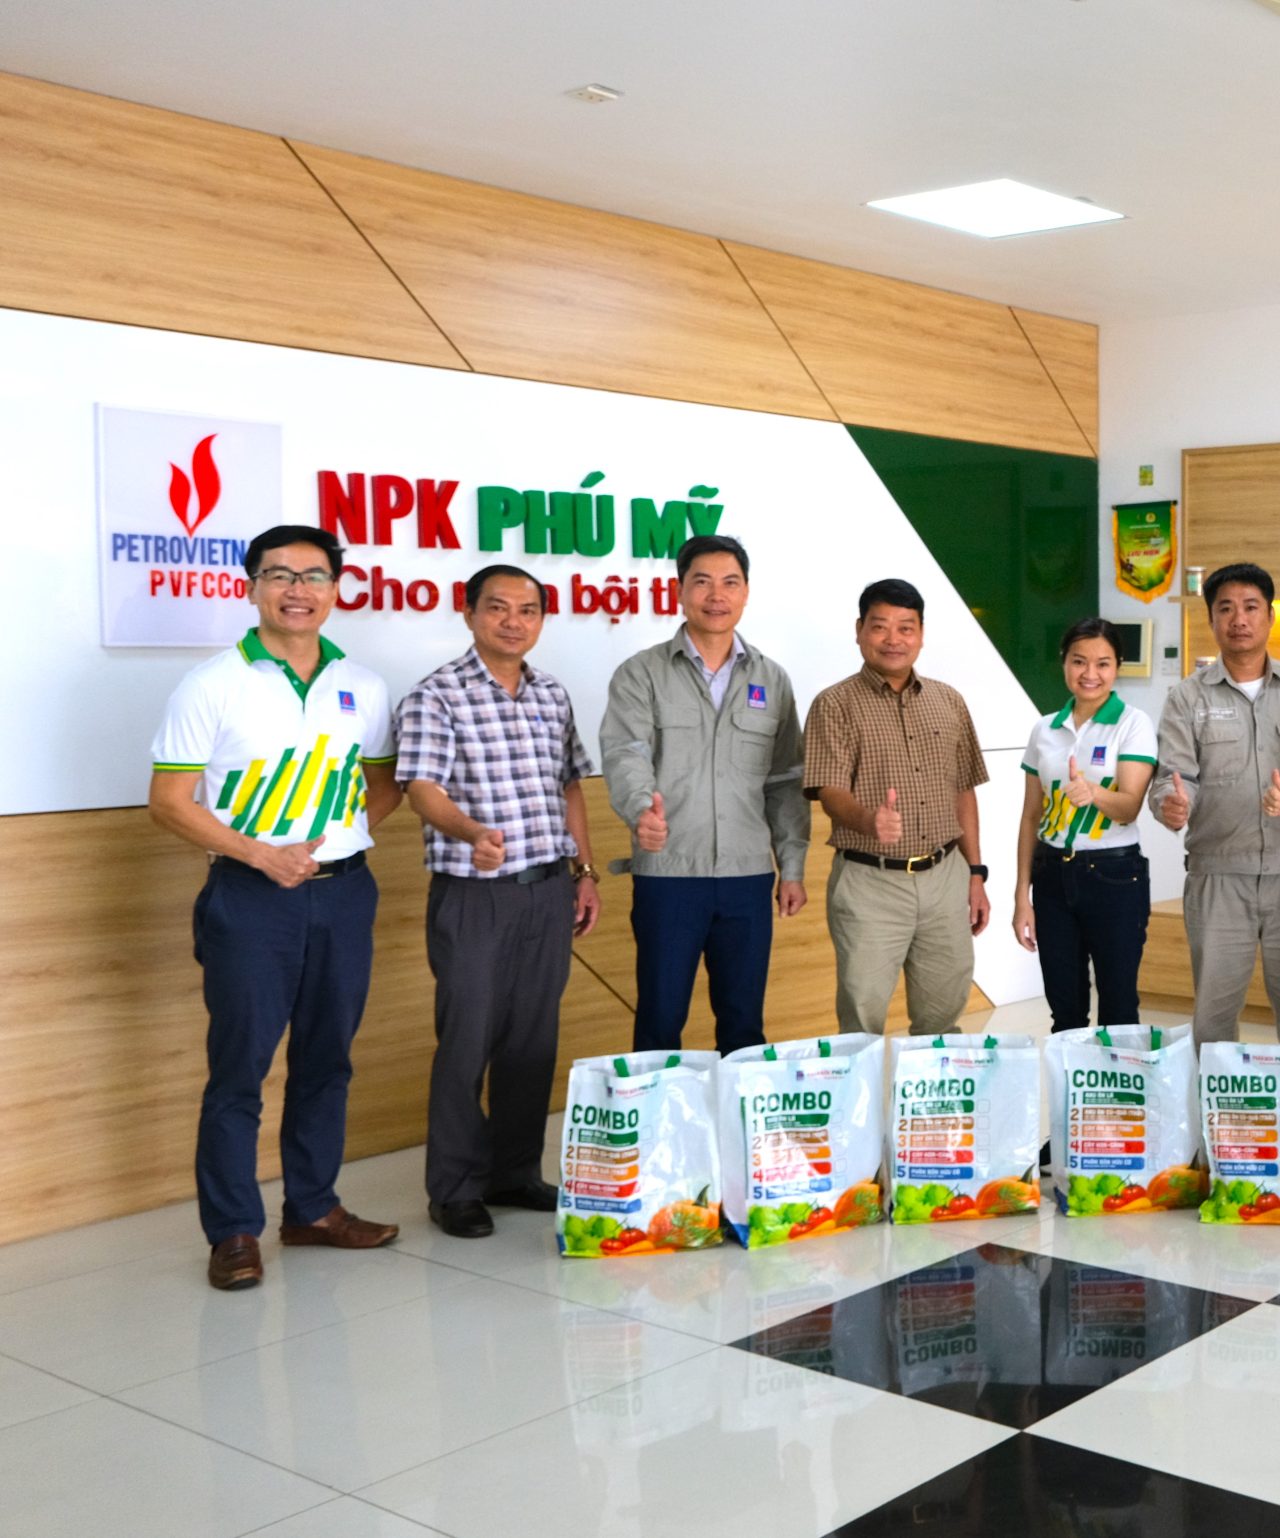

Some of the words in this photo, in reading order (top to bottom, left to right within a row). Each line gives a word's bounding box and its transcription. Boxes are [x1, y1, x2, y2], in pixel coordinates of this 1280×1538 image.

[317, 470, 461, 549] NPK
[478, 470, 615, 557] PHÚ
[631, 485, 724, 560] MỸ
[112, 533, 247, 566] PETROVIETN
[150, 569, 247, 599] PVFCCo
[336, 564, 440, 613] Cho
[571, 573, 639, 624] bội
[1073, 1069, 1144, 1090] COMBO
[1207, 1075, 1277, 1093] COMBO
[902, 1078, 975, 1099] COMBO
[753, 1090, 832, 1113] COMBO
[1071, 1092, 1076, 1105] 1
[1206, 1097, 1212, 1110] 1
[899, 1103, 905, 1116] 1
[1071, 1108, 1079, 1121] 2
[572, 1104, 639, 1130] COMBO
[1207, 1113, 1215, 1125] 2
[752, 1119, 757, 1133] 1
[899, 1119, 907, 1131] 2
[1071, 1124, 1078, 1137] 3
[568, 1128, 574, 1142] 1
[898, 1135, 906, 1147] 3
[752, 1136, 762, 1150] 2
[1070, 1140, 1079, 1153] 4
[566, 1145, 574, 1159] 2
[897, 1149, 907, 1162] 4
[752, 1153, 762, 1167] 3
[1070, 1156, 1078, 1168] 5
[565, 1162, 573, 1177] 3
[752, 1169, 763, 1183] 4
[897, 1165, 906, 1178] 5
[753, 1186, 763, 1199] 5
